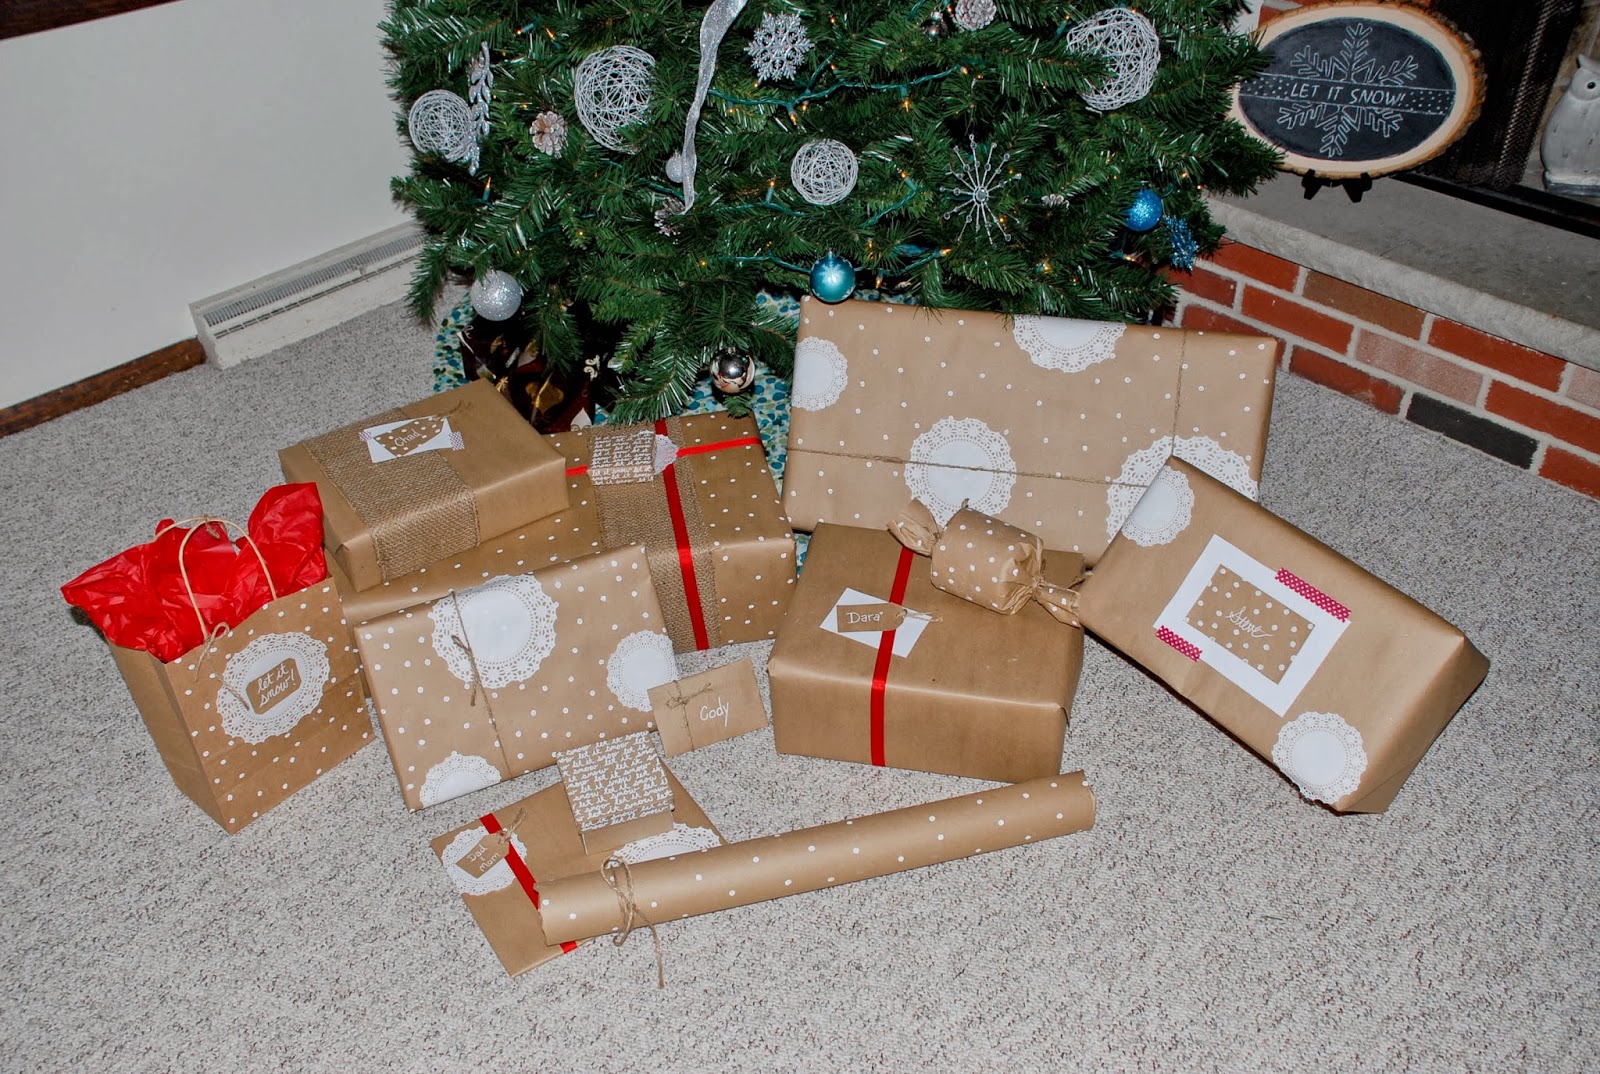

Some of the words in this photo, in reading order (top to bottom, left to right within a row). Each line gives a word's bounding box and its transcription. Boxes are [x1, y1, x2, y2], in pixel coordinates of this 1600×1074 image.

[1290, 83, 1320, 98] LET
[1327, 86, 1344, 100] IT
[1349, 88, 1405, 106] SNOW!
[394, 428, 422, 447] Chad
[846, 611, 881, 624] Dara
[258, 673, 274, 694] let
[276, 664, 289, 680] it
[700, 696, 730, 728] Cody
[466, 844, 488, 862] Dad
